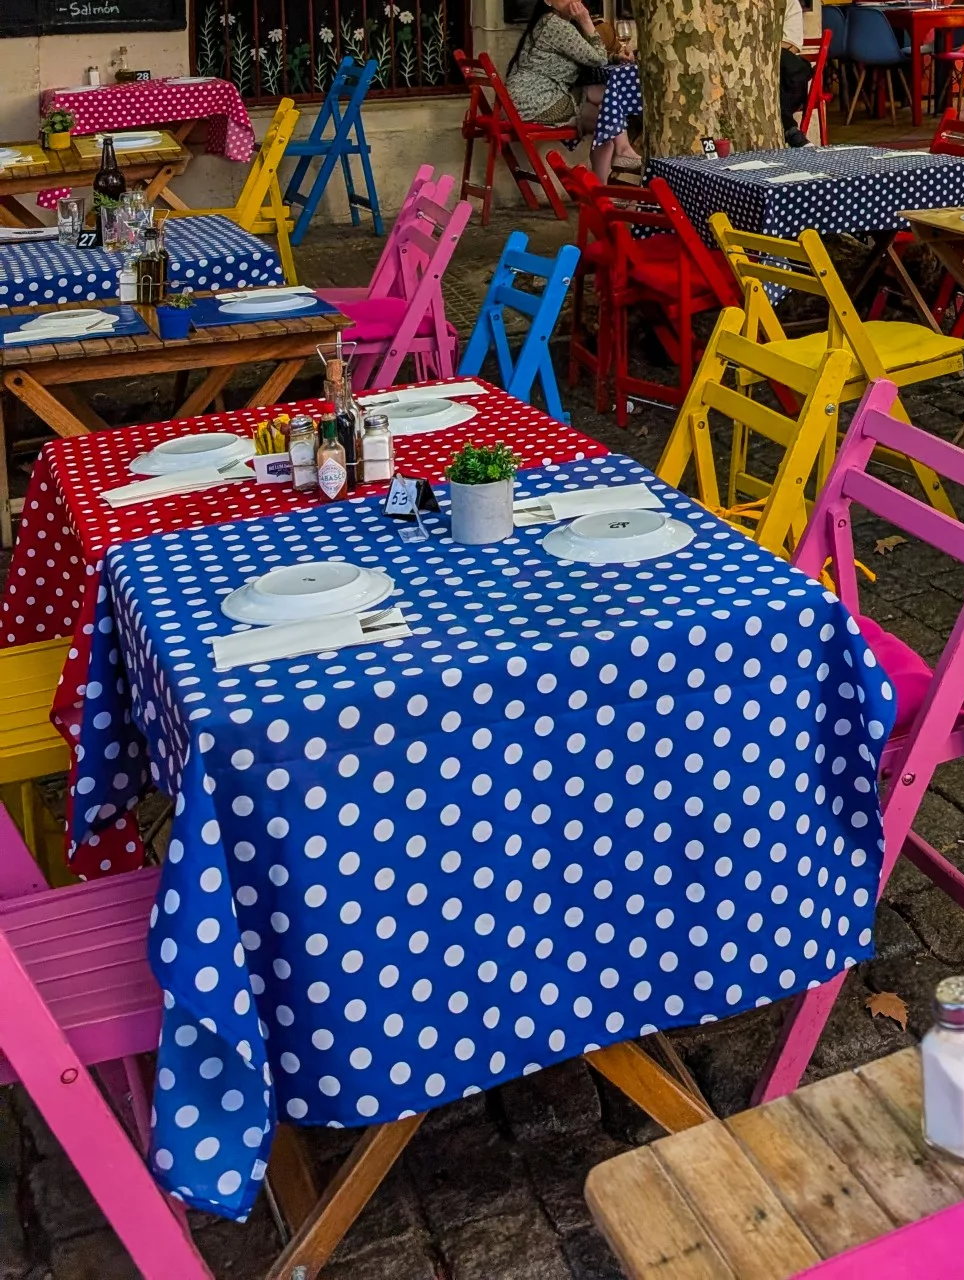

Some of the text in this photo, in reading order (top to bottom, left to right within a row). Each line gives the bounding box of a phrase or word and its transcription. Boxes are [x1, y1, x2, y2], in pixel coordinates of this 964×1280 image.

[69, 0, 120, 17] Salmón
[136, 72, 150, 81] 28
[703, 140, 716, 152] 26
[78, 232, 97, 248] 27
[391, 491, 408, 505] 53
